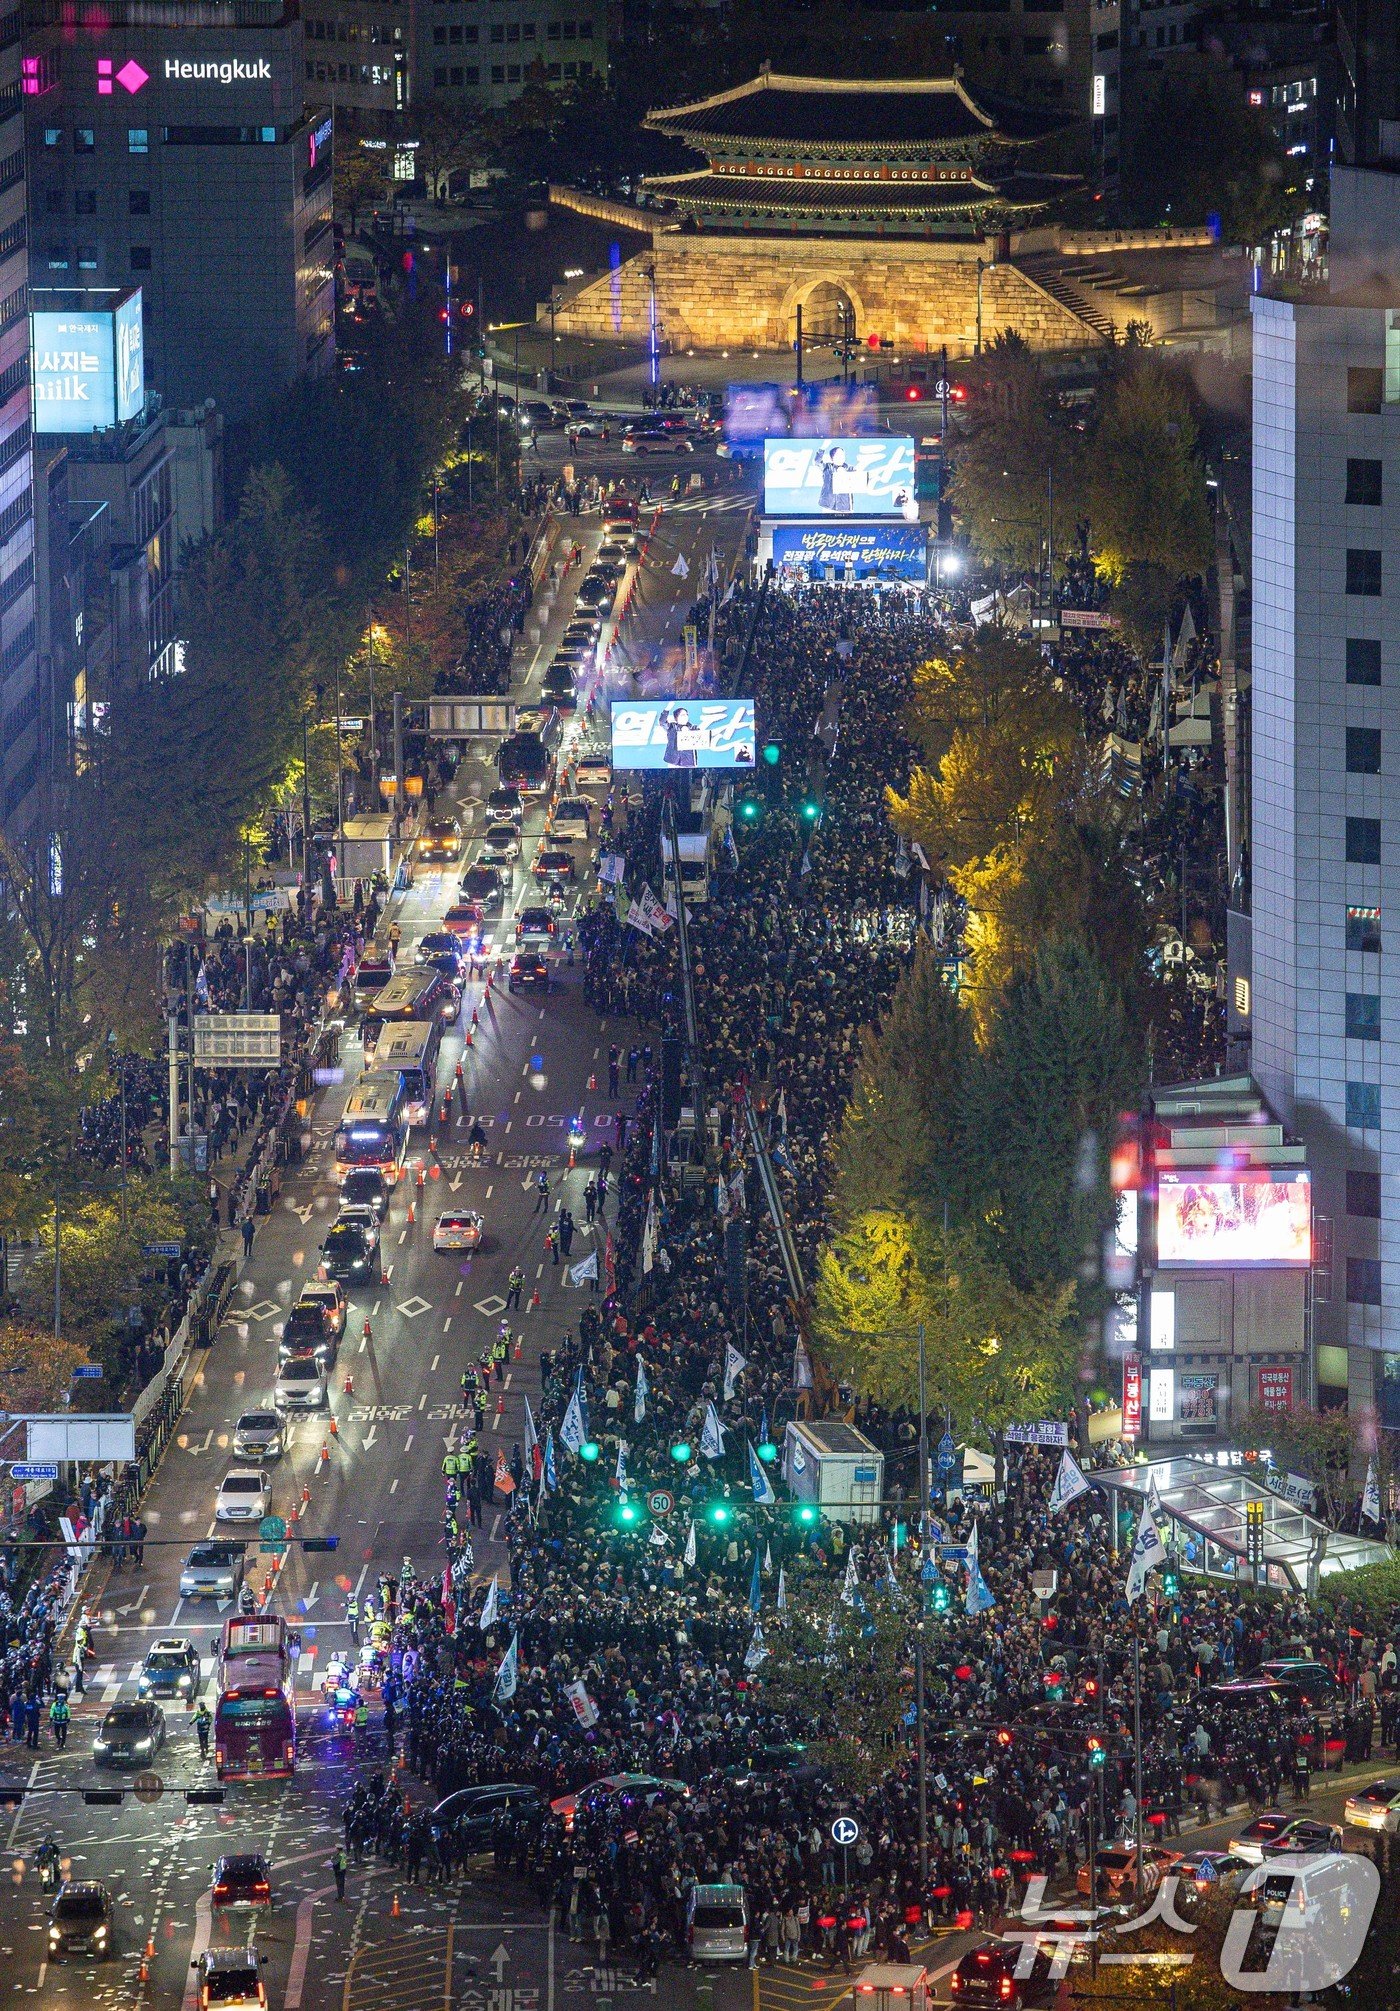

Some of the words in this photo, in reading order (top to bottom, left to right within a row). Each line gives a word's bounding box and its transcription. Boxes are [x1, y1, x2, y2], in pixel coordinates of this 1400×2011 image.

[165, 59, 272, 84] Heungkuk
[69, 324, 98, 332] 한국제지
[861, 548, 915, 566] 탄핵하자!
[526, 1115, 565, 1127] 50
[1182, 1375, 1216, 1388] 부동산
[1261, 1372, 1289, 1383] 전국부동산
[1127, 1367, 1139, 1415] 부동산
[1003, 1431, 1028, 1441] 석열을
[1269, 1477, 1313, 1501] 서대문(갑
[653, 1497, 669, 1510] 50
[1266, 1889, 1287, 1898] POLICE
